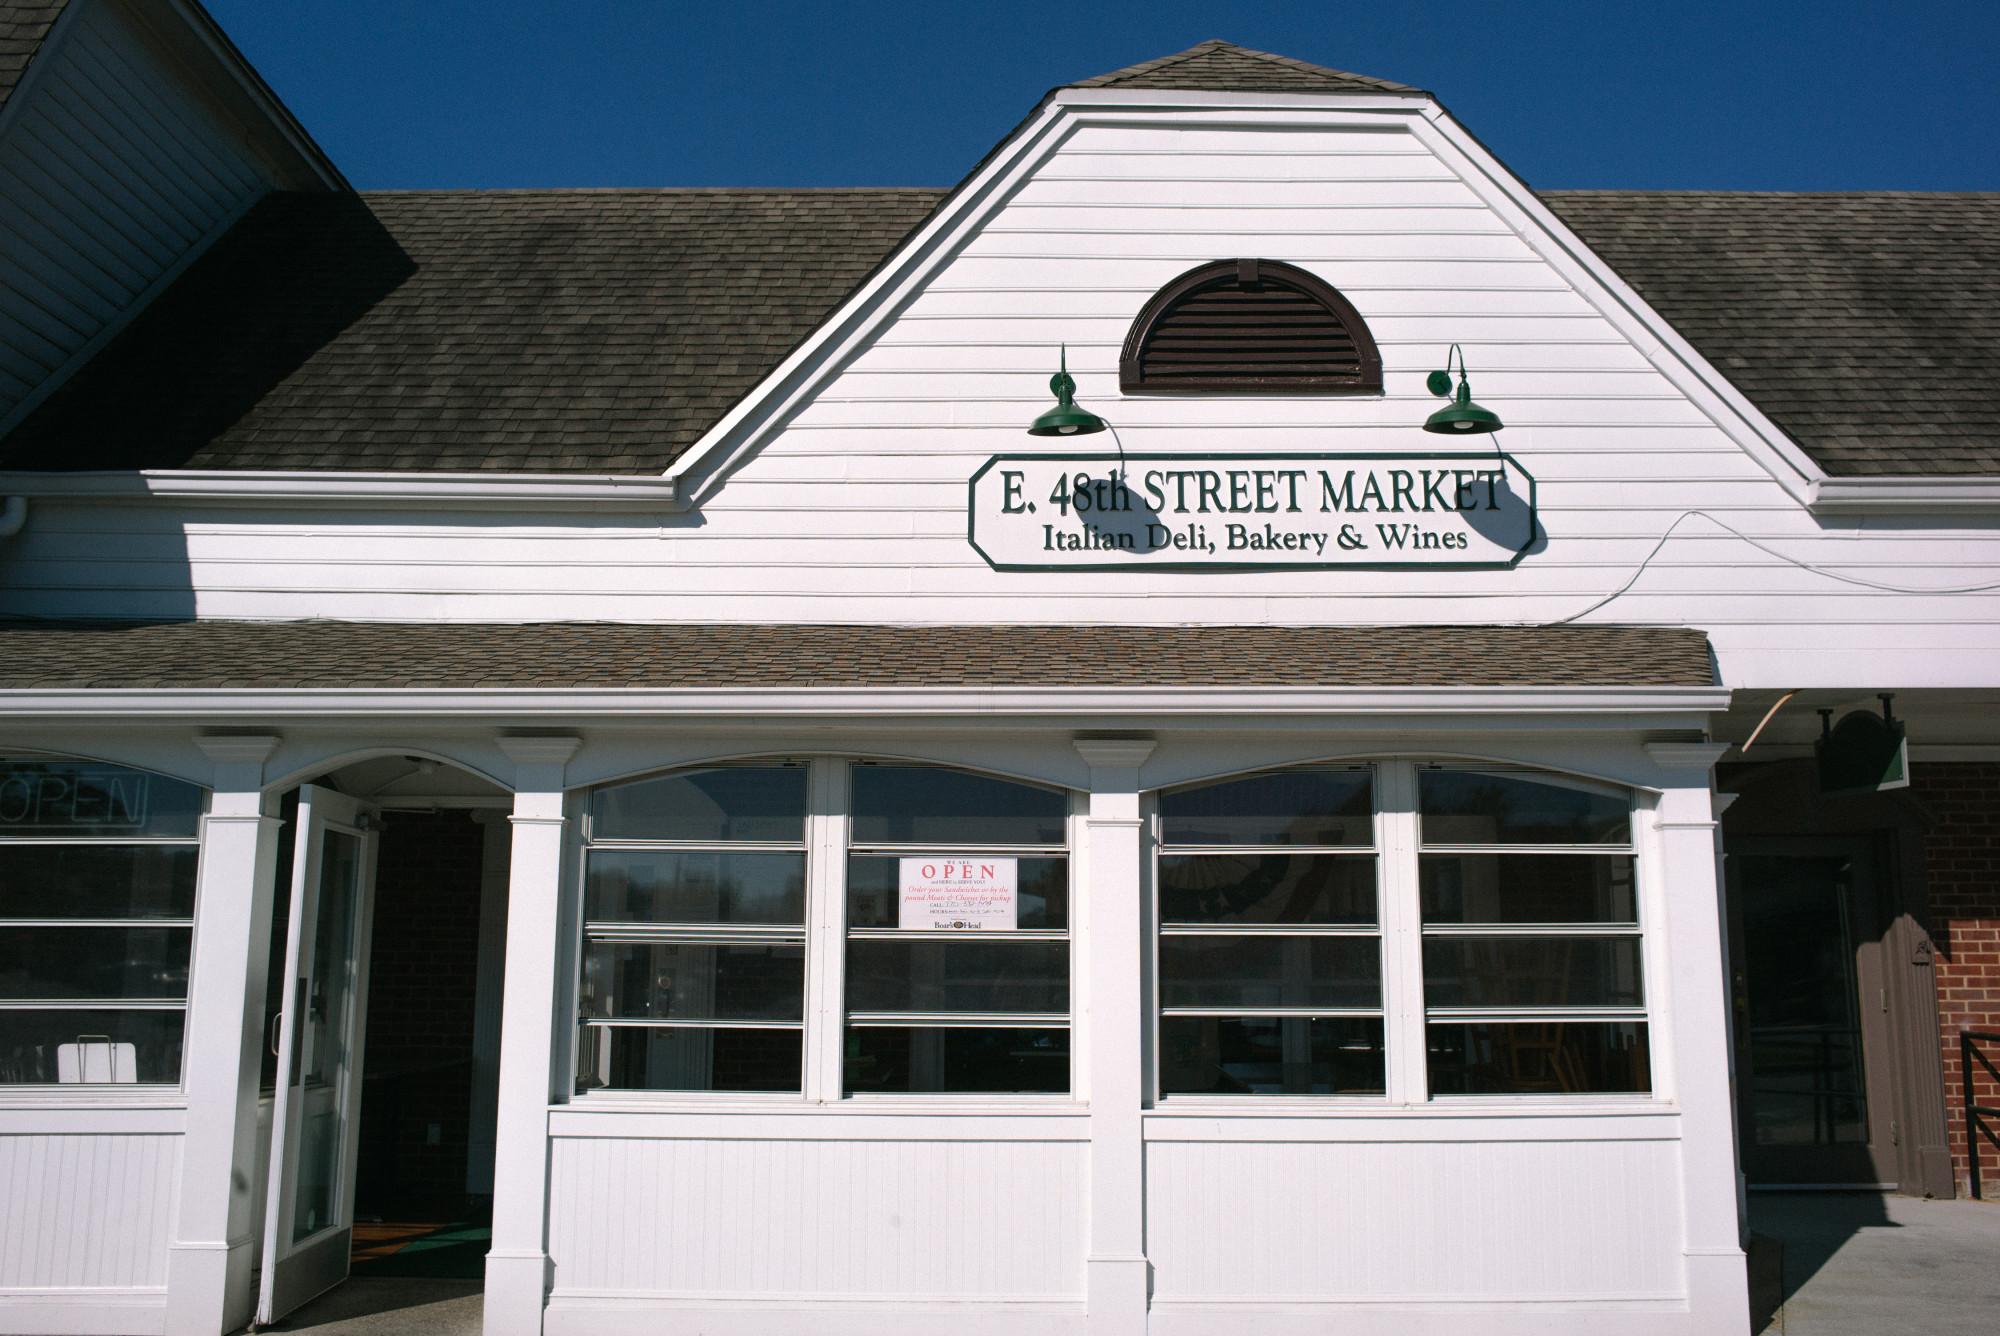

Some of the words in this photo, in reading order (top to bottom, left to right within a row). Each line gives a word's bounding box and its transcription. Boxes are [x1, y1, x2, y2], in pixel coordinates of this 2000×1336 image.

[1000, 470, 1037, 514] E.
[1049, 469, 1133, 516] 48th
[1144, 469, 1307, 514] STREET
[1317, 469, 1504, 513] MARKET
[1043, 523, 1135, 551] Italian
[1145, 522, 1216, 555] Deli,
[1225, 522, 1328, 556] Bakery
[1337, 523, 1368, 551] &
[1376, 523, 1468, 551] Wines
[0, 777, 141, 822] OPEN
[921, 864, 995, 879] OPEN
